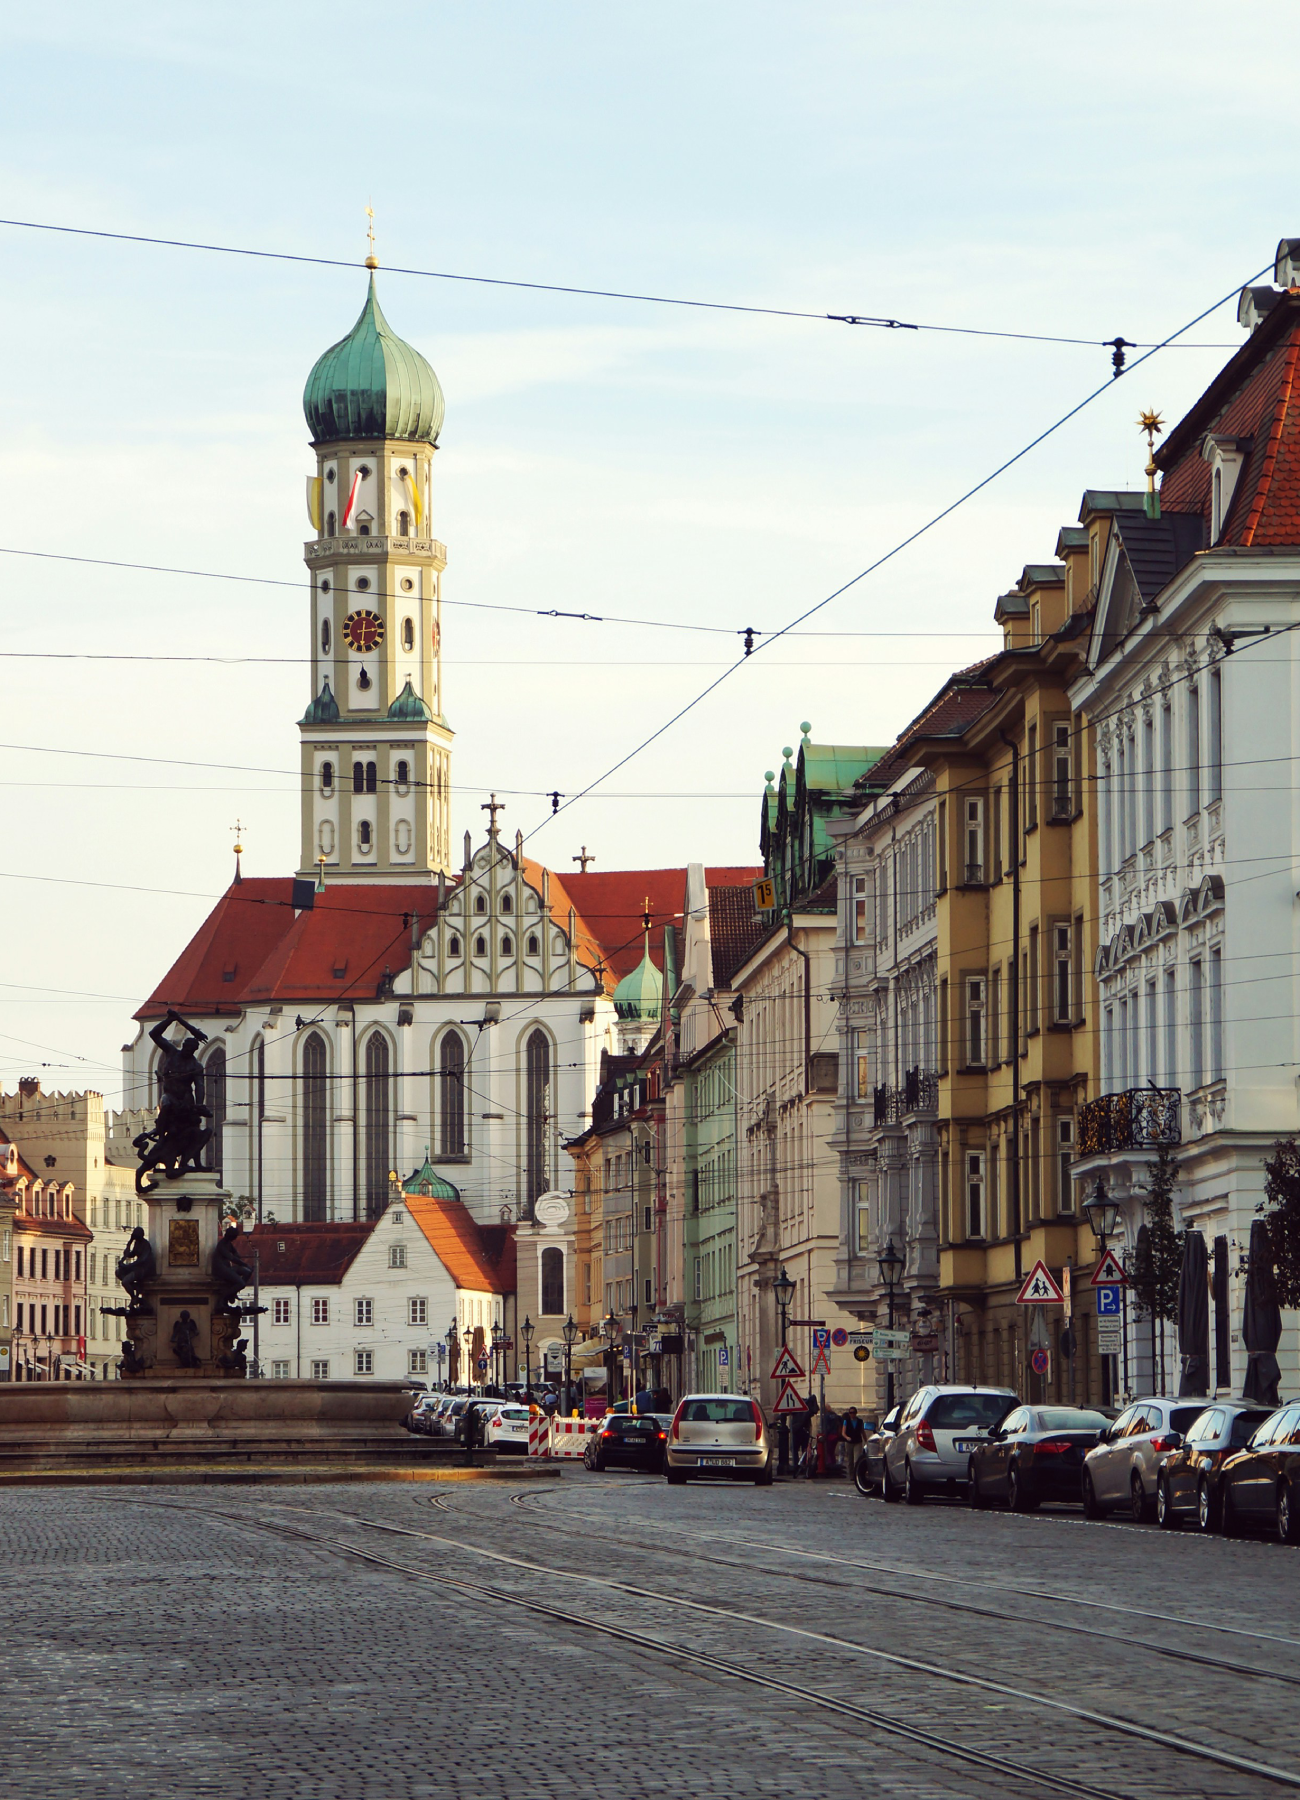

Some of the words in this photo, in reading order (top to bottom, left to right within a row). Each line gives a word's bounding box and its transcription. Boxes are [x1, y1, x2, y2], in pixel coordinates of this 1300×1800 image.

[757, 883, 772, 905] 15
[1100, 1289, 1113, 1311] P
[817, 1331, 827, 1346] P
[720, 1351, 727, 1364] P
